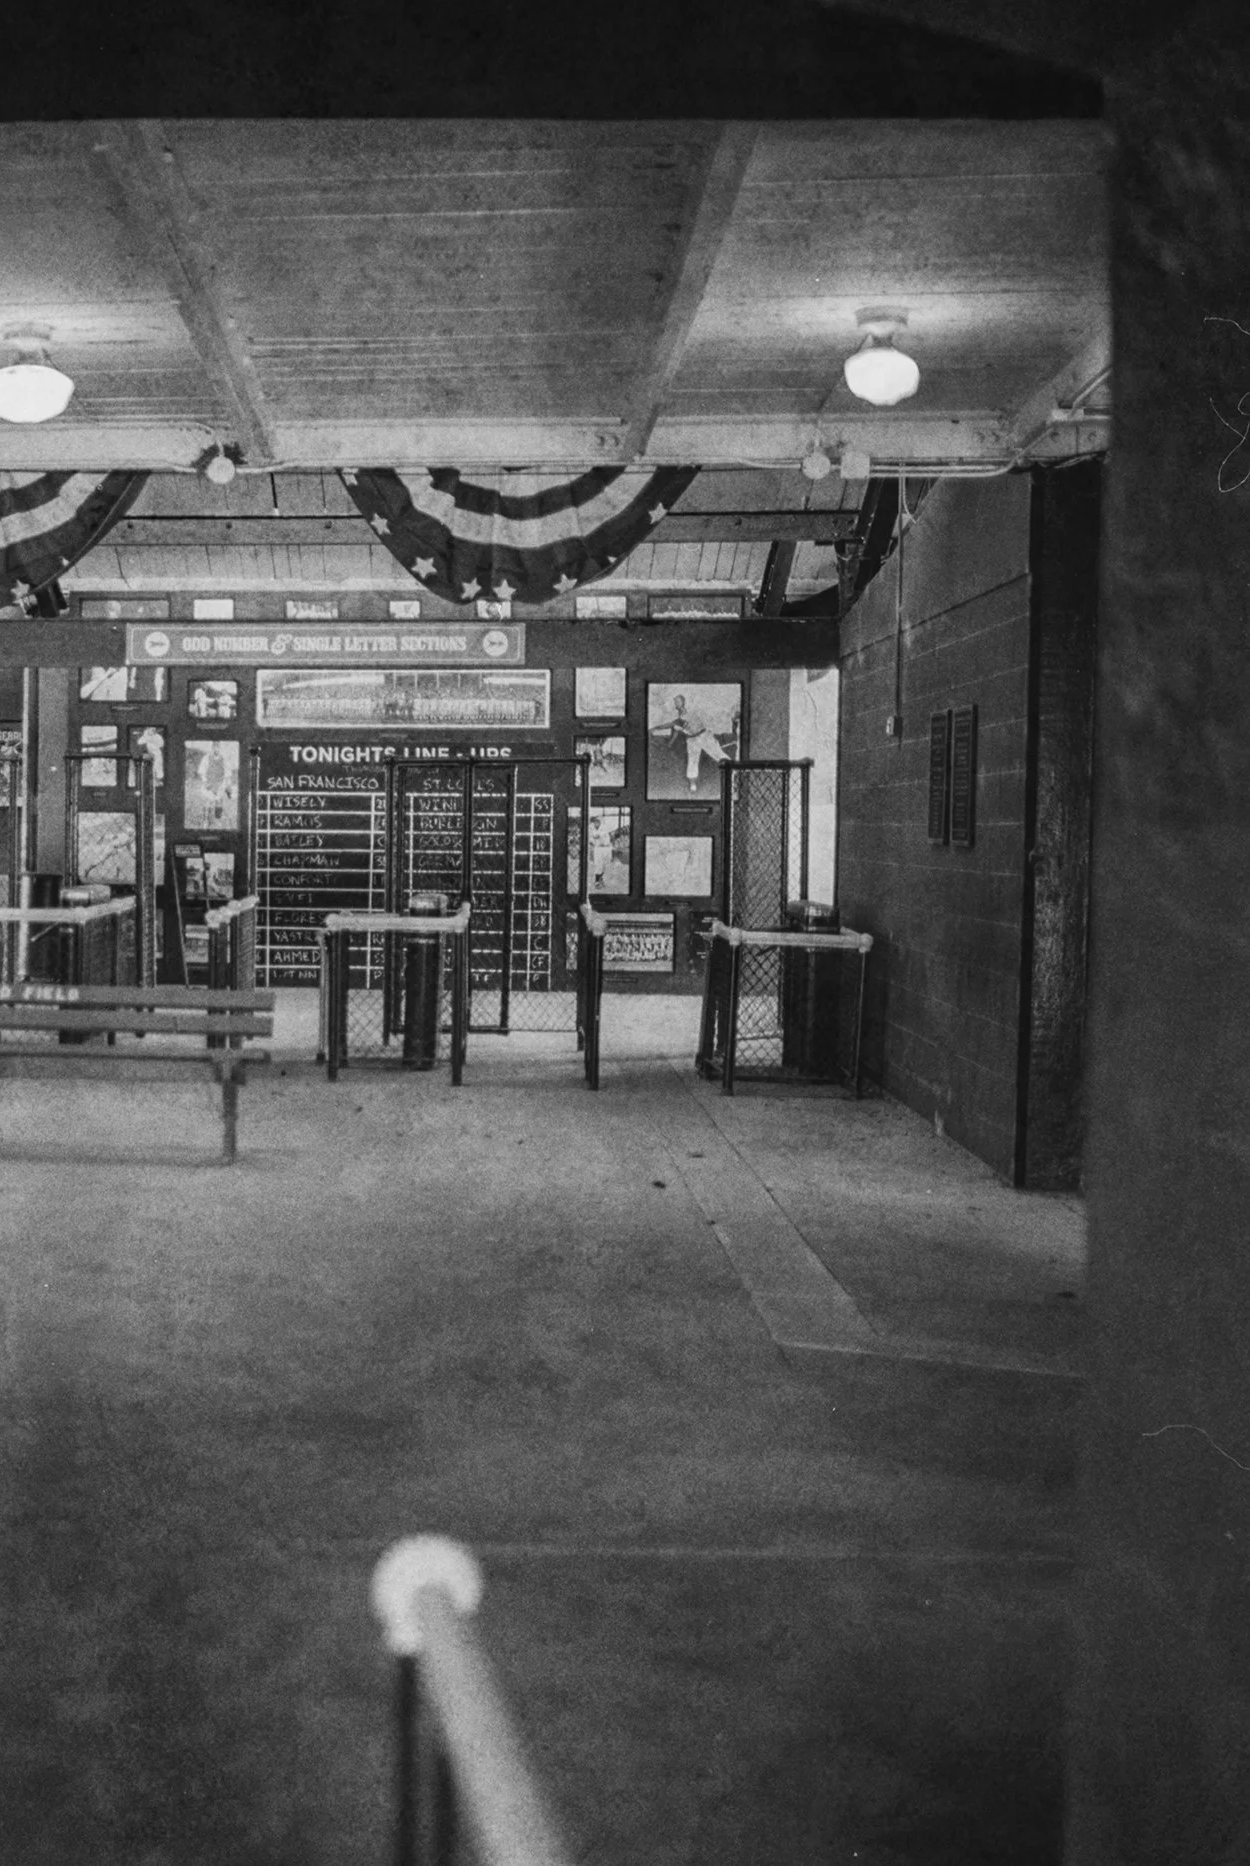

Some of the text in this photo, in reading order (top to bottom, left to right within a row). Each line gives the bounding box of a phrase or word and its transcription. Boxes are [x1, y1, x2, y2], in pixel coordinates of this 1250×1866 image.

[182, 637, 211, 652] ODD
[213, 637, 268, 652] NUMBER
[293, 637, 342, 652] SINGLE
[344, 637, 397, 652] LETTER
[400, 637, 468, 652] SECTIONS
[266, 775, 379, 791] SAN FRANCISCO
[272, 796, 326, 809] WISELY
[273, 815, 323, 829] RAMOS
[420, 816, 497, 829] BURLEON
[273, 951, 321, 963] AHMED
